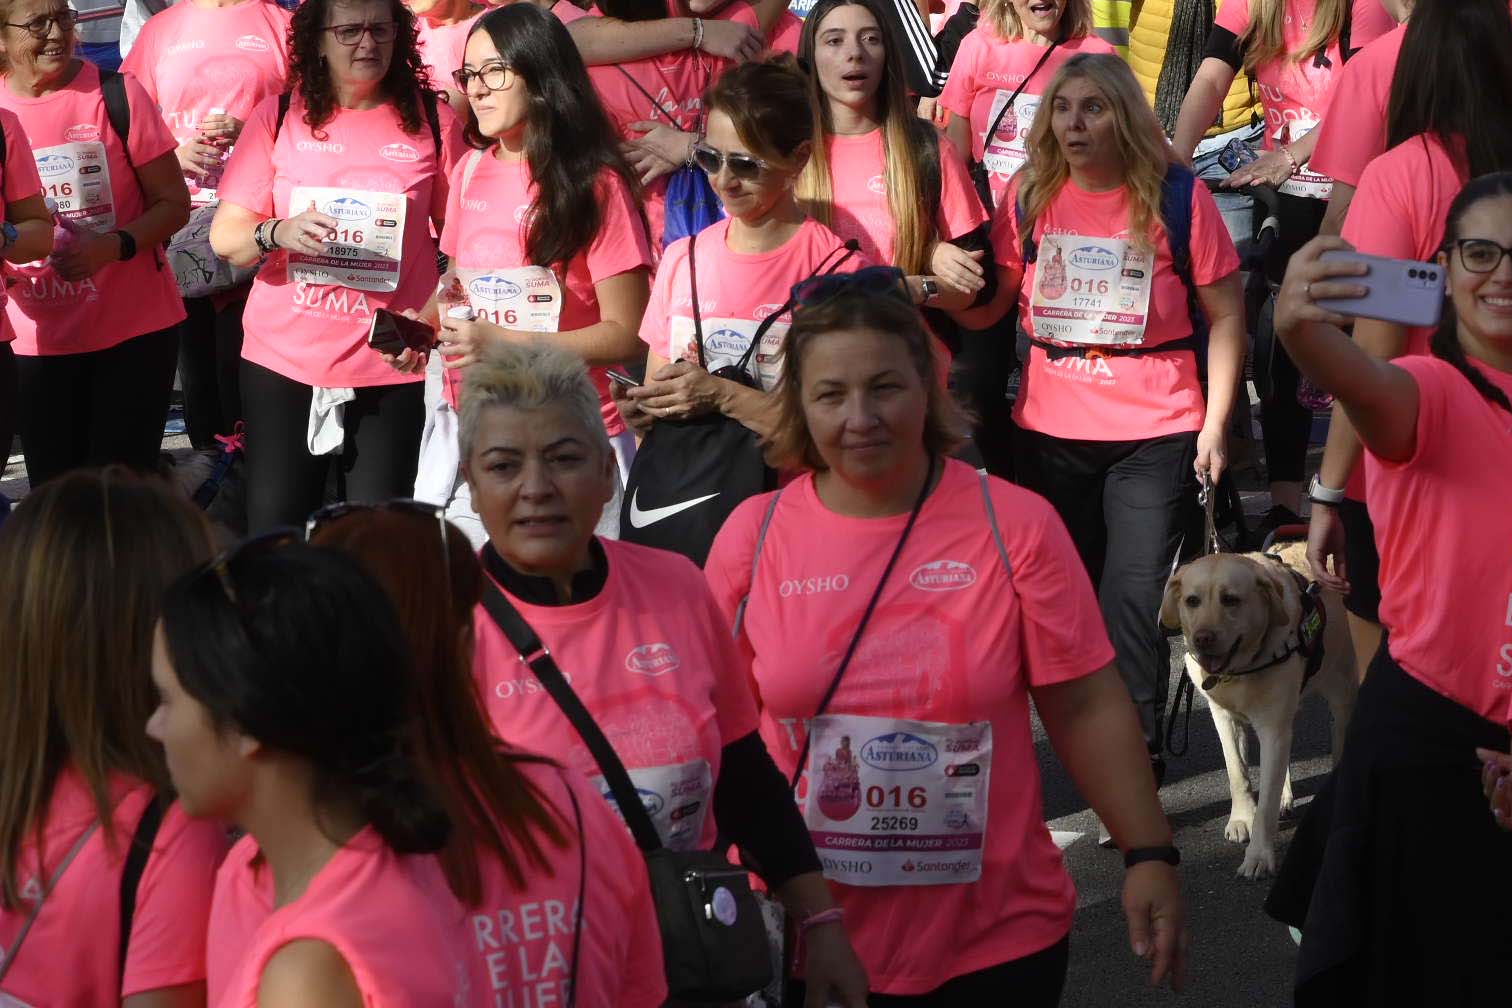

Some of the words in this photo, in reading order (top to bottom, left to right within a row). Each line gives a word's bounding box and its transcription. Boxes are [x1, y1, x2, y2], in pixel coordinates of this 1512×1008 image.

[986, 70, 1026, 83] OYSHO
[296, 142, 344, 154] OYSHO
[77, 153, 98, 161] SUMA
[328, 205, 371, 217] ASTURIANA
[1071, 255, 1115, 267] ASTURIANA
[355, 276, 391, 285] Santander
[526, 279, 550, 290] SUMA
[1070, 278, 1109, 294] 016
[470, 280, 520, 295] ASTURIANA
[293, 284, 371, 314] SUMA
[1073, 296, 1102, 308] 17741
[1042, 309, 1075, 318] CARRERA
[1041, 322, 1072, 334] OYSHO
[779, 573, 849, 597] OYSHO
[912, 571, 974, 587] ASTURIANA
[864, 745, 935, 762] ASTURIANA
[945, 742, 980, 753] SUMA
[866, 785, 928, 809] 016
[870, 816, 919, 832] 25269
[824, 836, 873, 848] CARRERA
[875, 837, 889, 848] DE
[890, 838, 904, 848] LA
[905, 839, 943, 849] MUJER
[916, 858, 972, 873] Santander
[518, 939, 569, 982] LA
